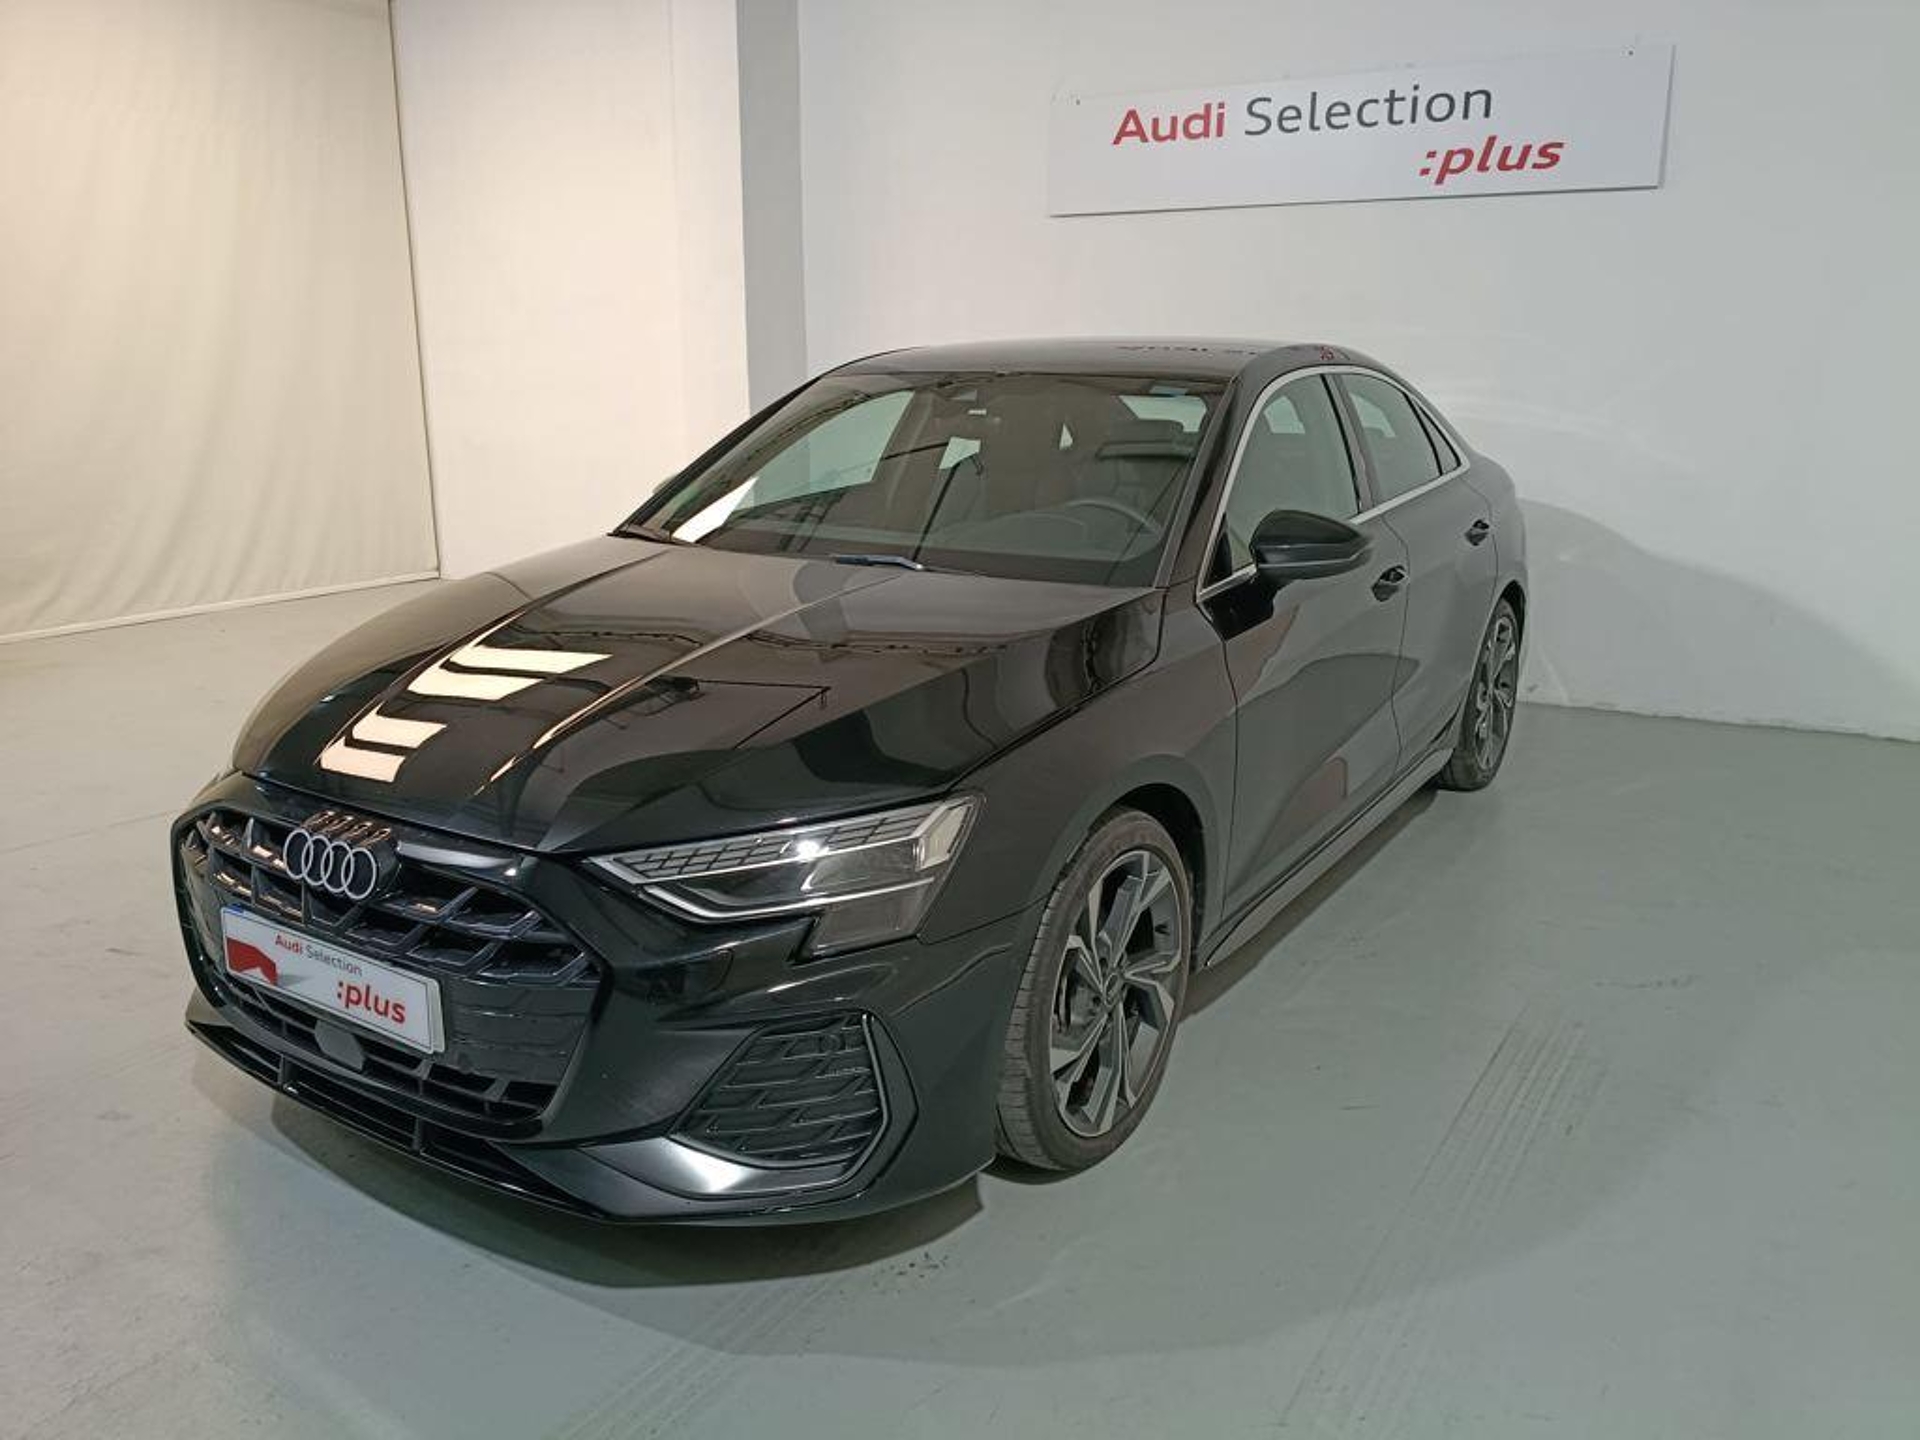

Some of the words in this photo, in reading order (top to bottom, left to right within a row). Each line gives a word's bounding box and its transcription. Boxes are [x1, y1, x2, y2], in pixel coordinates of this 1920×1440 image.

[1113, 102, 1227, 145] Audi
[1244, 83, 1493, 136] Selection
[1418, 134, 1565, 185] :plus
[275, 933, 303, 953] Audi
[305, 945, 362, 977] Selection
[337, 981, 406, 1024] :plus
